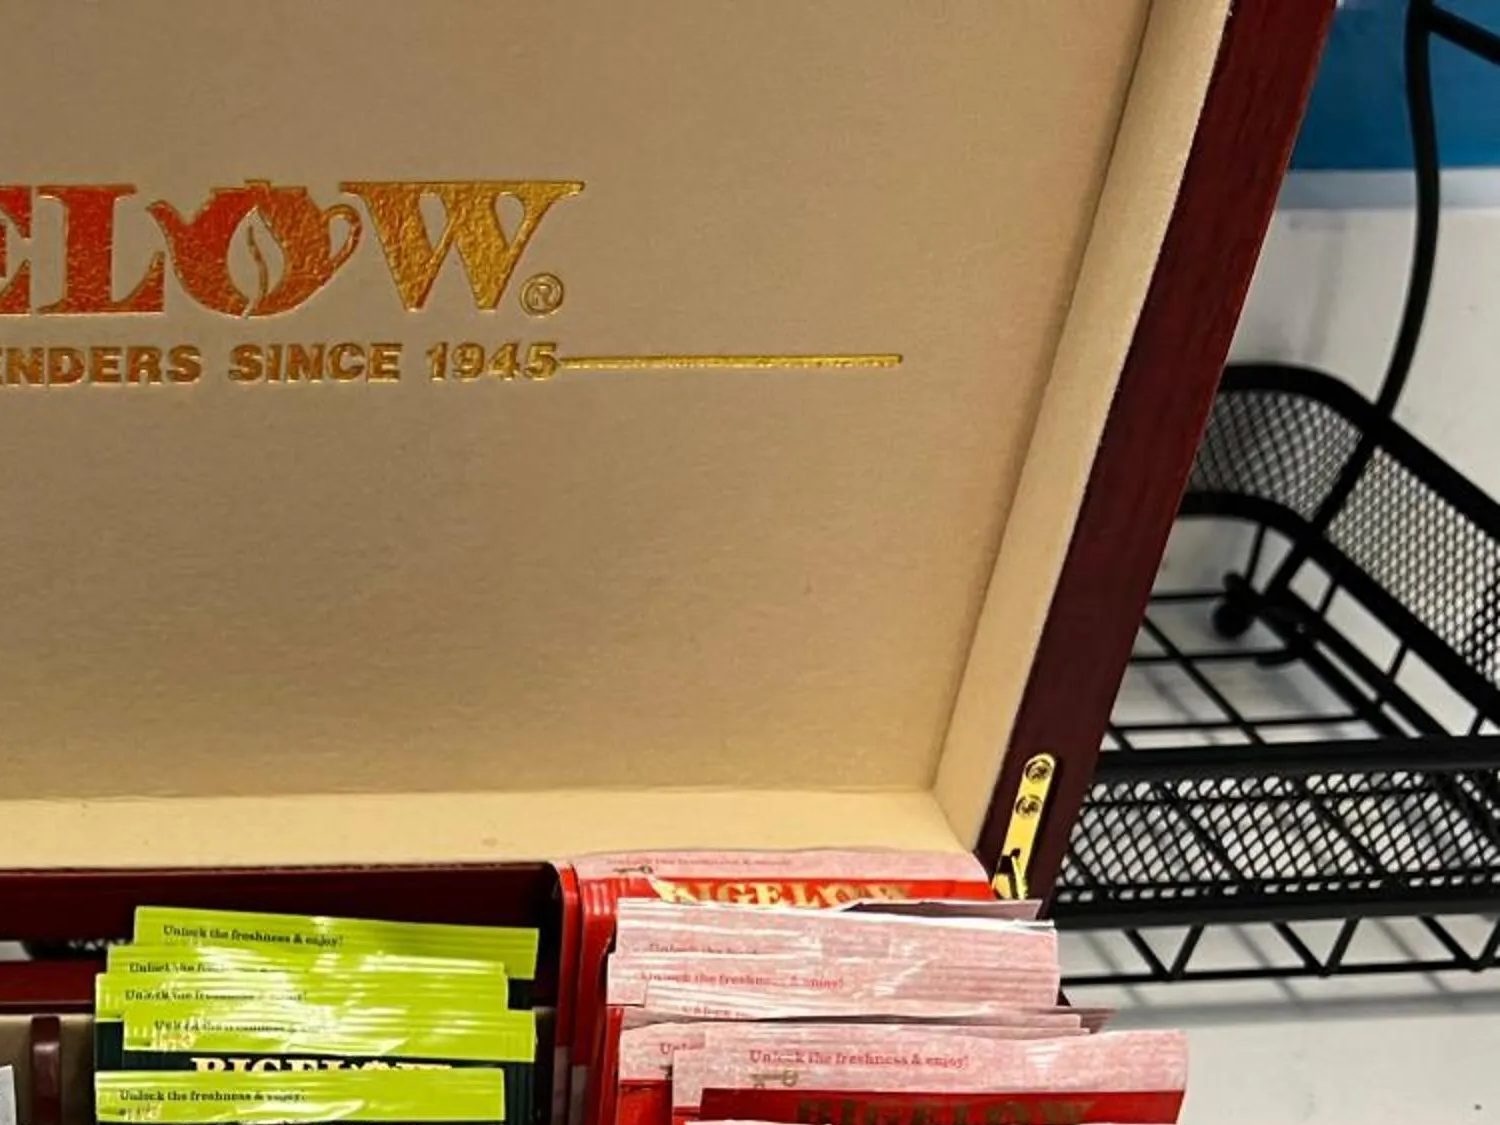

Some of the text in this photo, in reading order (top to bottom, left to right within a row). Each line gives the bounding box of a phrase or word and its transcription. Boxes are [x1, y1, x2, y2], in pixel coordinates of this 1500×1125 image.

[228, 342, 402, 384] SINCE
[425, 341, 558, 381] 1945
[209, 927, 229, 939] the
[231, 928, 291, 943] freshness
[167, 1090, 187, 1101] the
